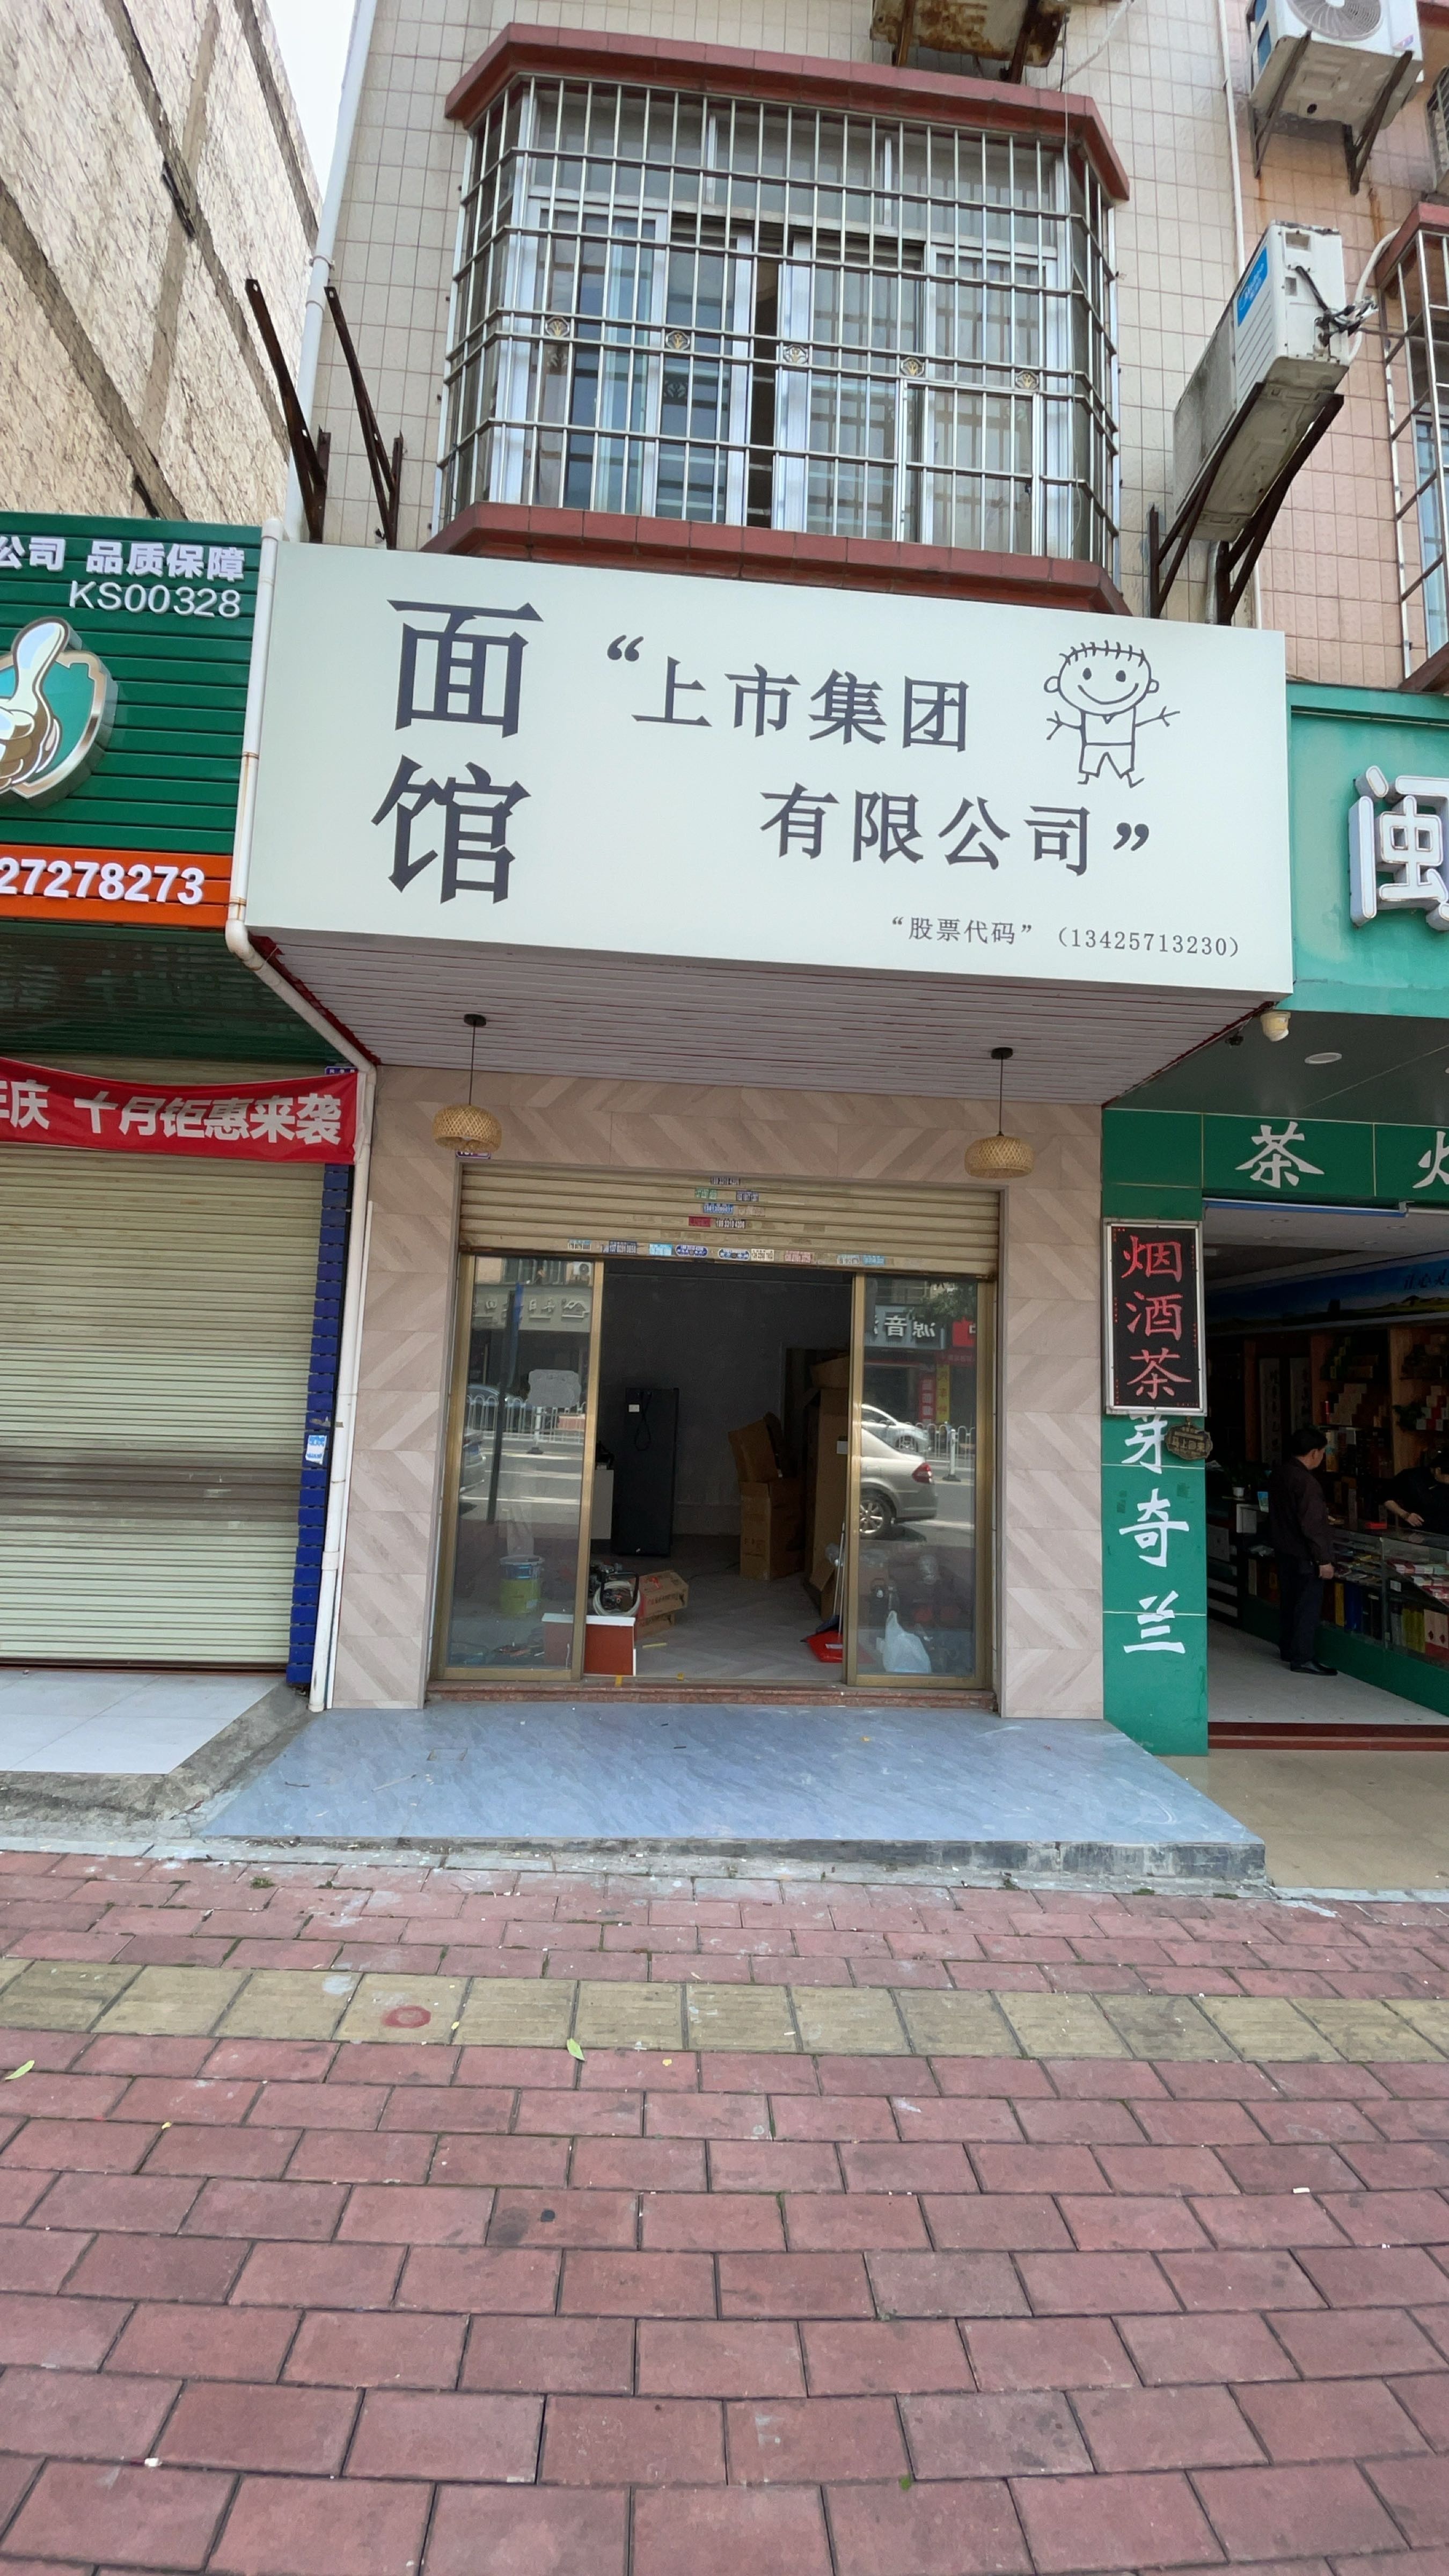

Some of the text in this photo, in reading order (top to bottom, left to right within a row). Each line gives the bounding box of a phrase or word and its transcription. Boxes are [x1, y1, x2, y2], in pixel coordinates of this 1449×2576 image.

[0, 536, 245, 582] 公司 品质保障
[69, 580, 241, 619] KS00328
[371, 599, 544, 904] 面馆
[0, 857, 204, 905] 27278273
[0, 1079, 341, 1145] 庆 十月钜惠来袭
[1235, 1121, 1324, 1189] 茶
[1121, 1235, 1192, 1400] 烟酒茶
